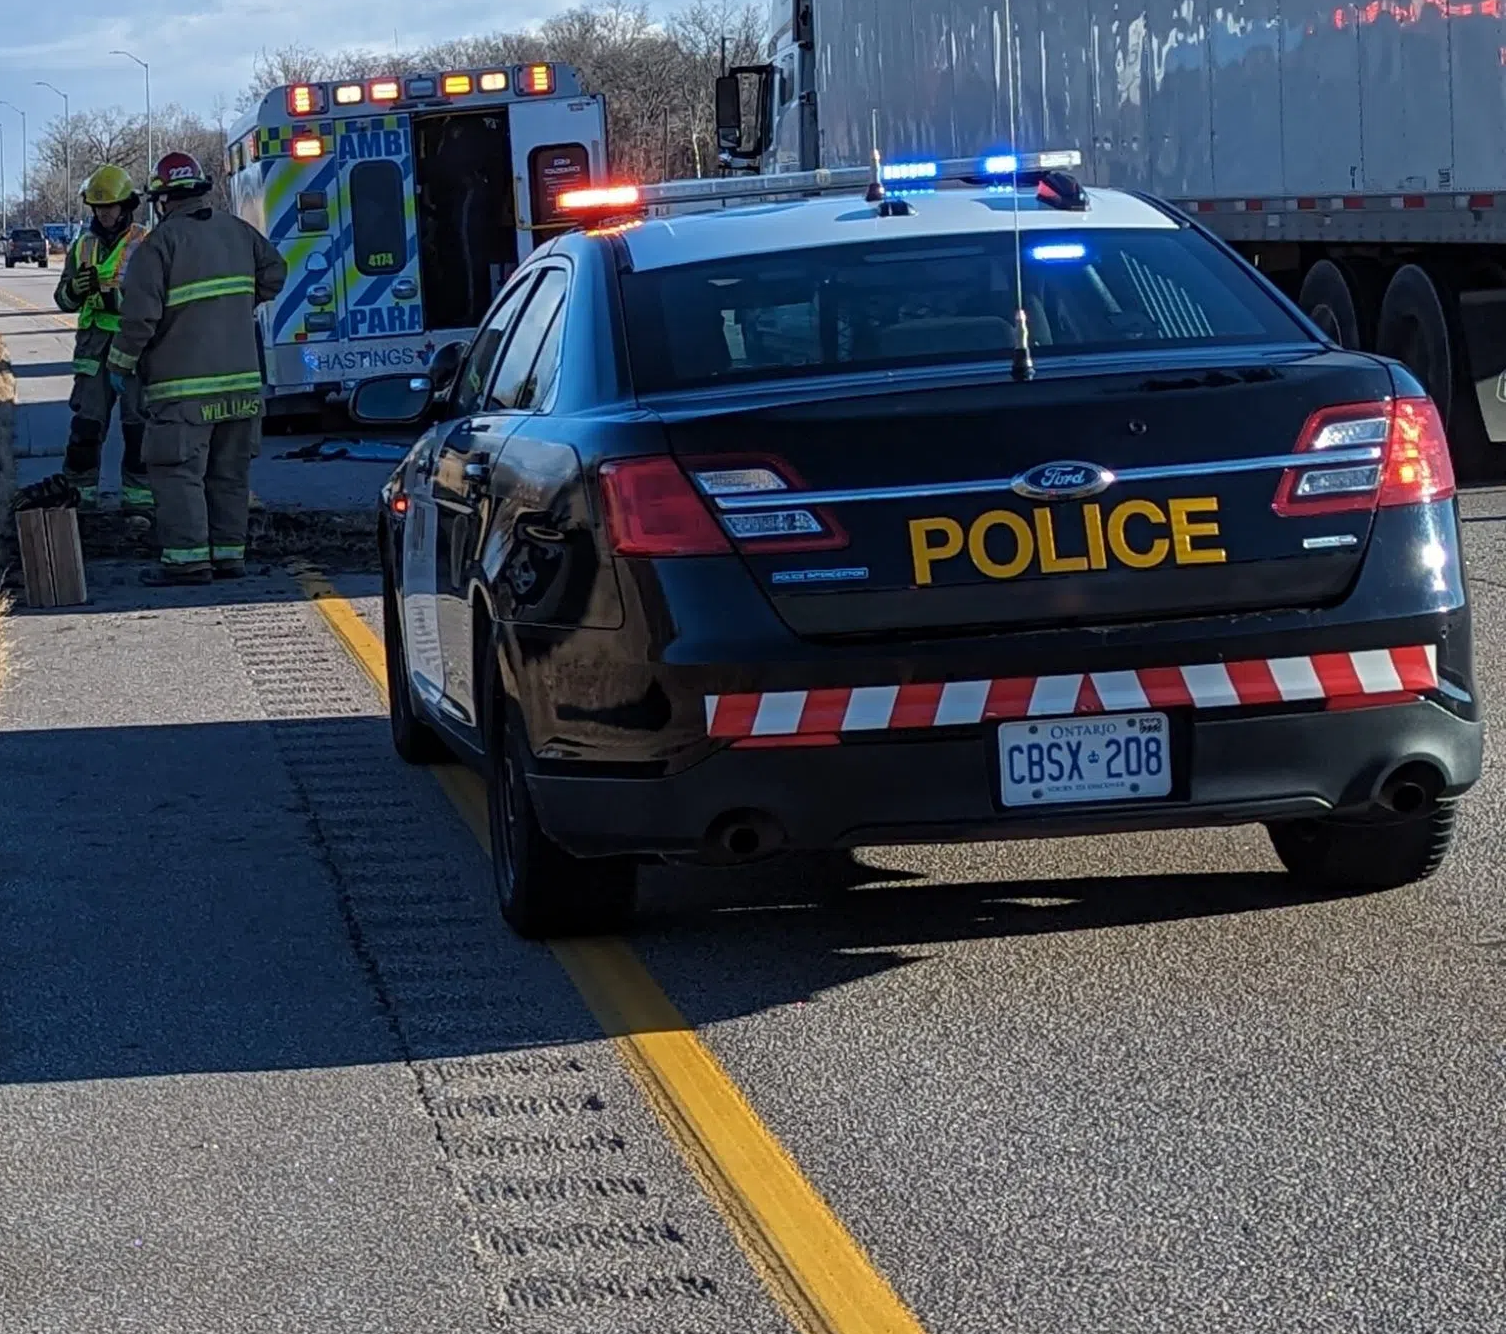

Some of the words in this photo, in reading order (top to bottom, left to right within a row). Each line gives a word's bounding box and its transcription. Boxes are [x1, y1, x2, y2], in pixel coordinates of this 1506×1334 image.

[169, 166, 194, 180] 222
[318, 346, 414, 370] HASTINGS
[1040, 467, 1085, 486] Ford
[908, 496, 1227, 585] POLICE
[1008, 740, 1084, 785] CBSX
[1105, 736, 1163, 779] 208
